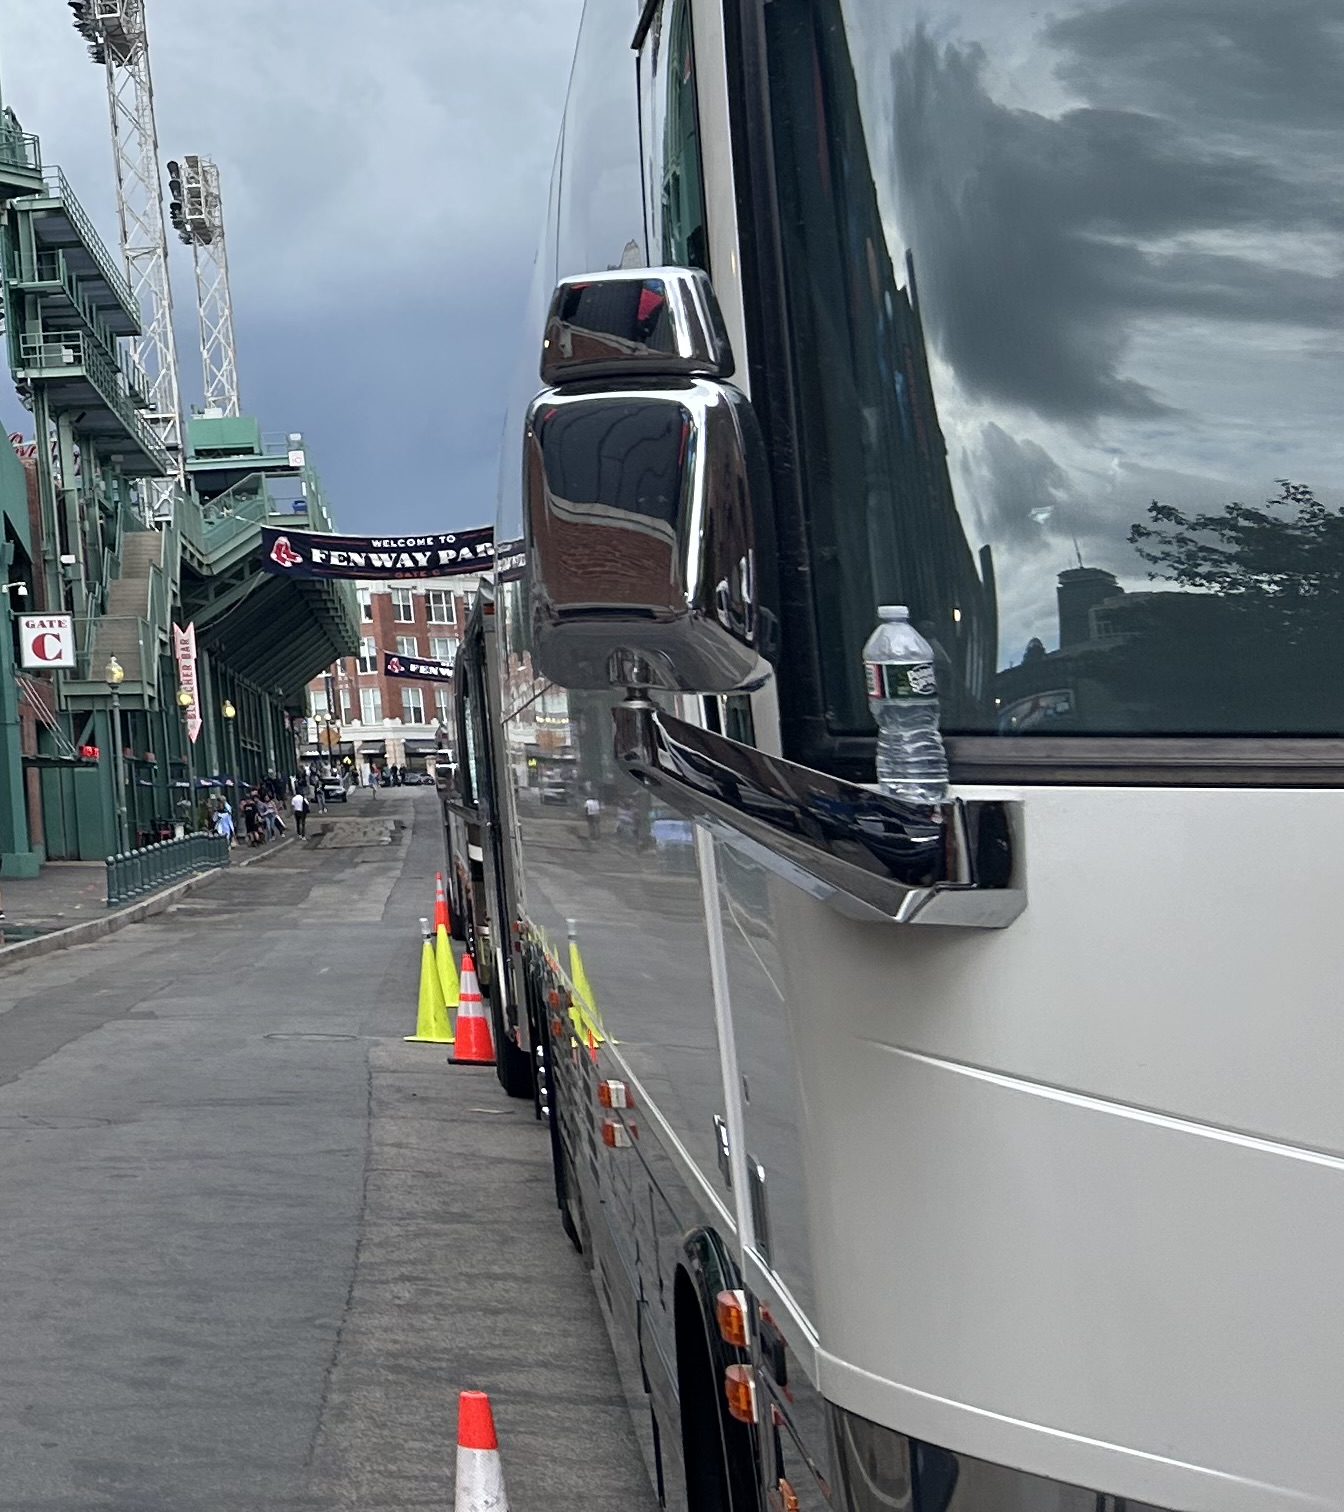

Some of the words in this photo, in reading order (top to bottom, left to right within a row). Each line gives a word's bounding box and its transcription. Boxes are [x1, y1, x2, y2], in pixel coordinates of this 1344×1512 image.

[372, 536, 434, 548] WELCOME
[439, 534, 456, 544] TO
[311, 548, 433, 568] FENWAY
[438, 542, 495, 565] PAR
[25, 620, 68, 628] GATE
[32, 632, 62, 661] C
